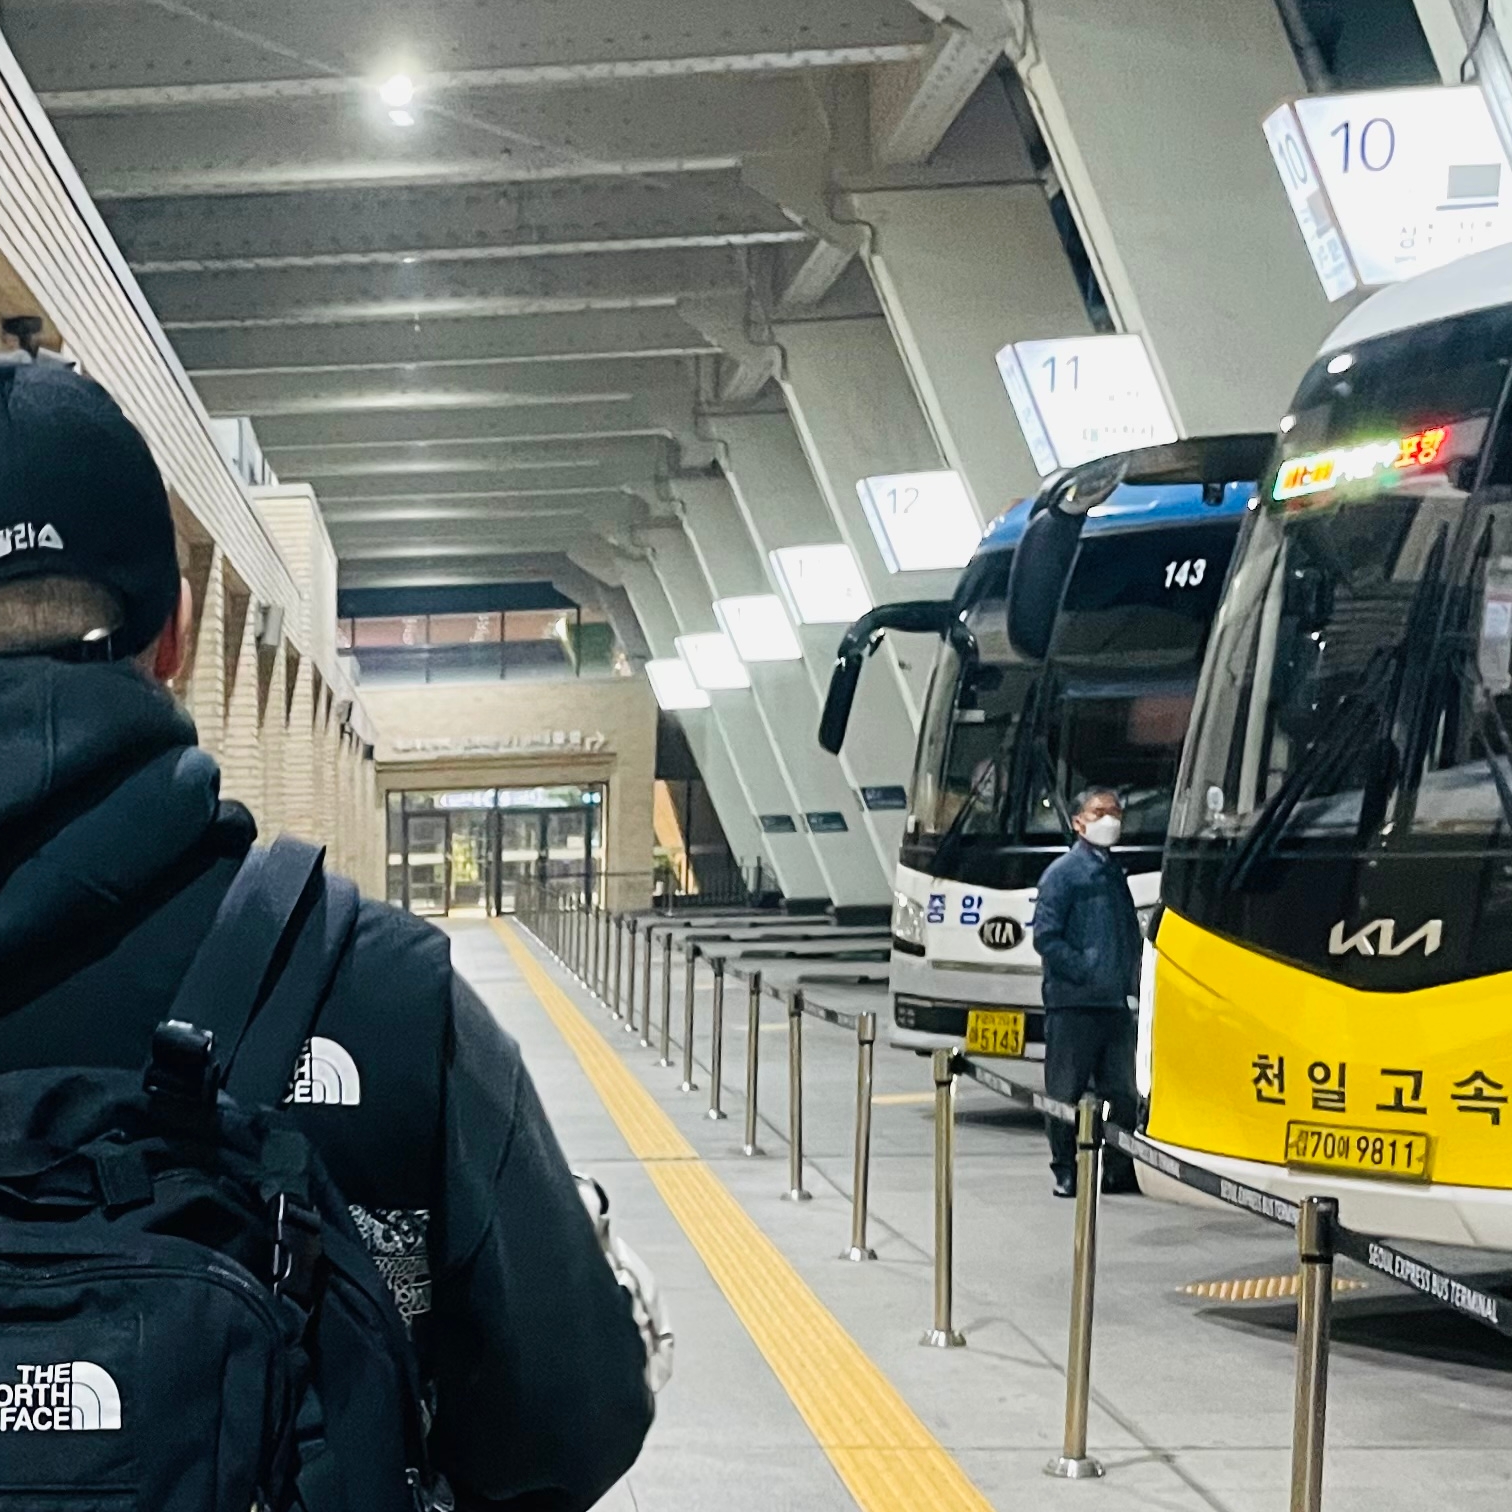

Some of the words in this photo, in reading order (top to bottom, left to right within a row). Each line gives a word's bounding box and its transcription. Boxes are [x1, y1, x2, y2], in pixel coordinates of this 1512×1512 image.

[1277, 133, 1308, 190] 10
[1330, 117, 1396, 174] 10
[1042, 355, 1079, 393] 11
[887, 487, 919, 514] 12
[1164, 558, 1207, 588] 143
[981, 921, 1016, 945] KIA
[1329, 918, 1443, 957] KIA
[1356, 1135, 1414, 1169] 9811
[16, 1362, 72, 1384] THE
[0, 1406, 71, 1432] FACE
